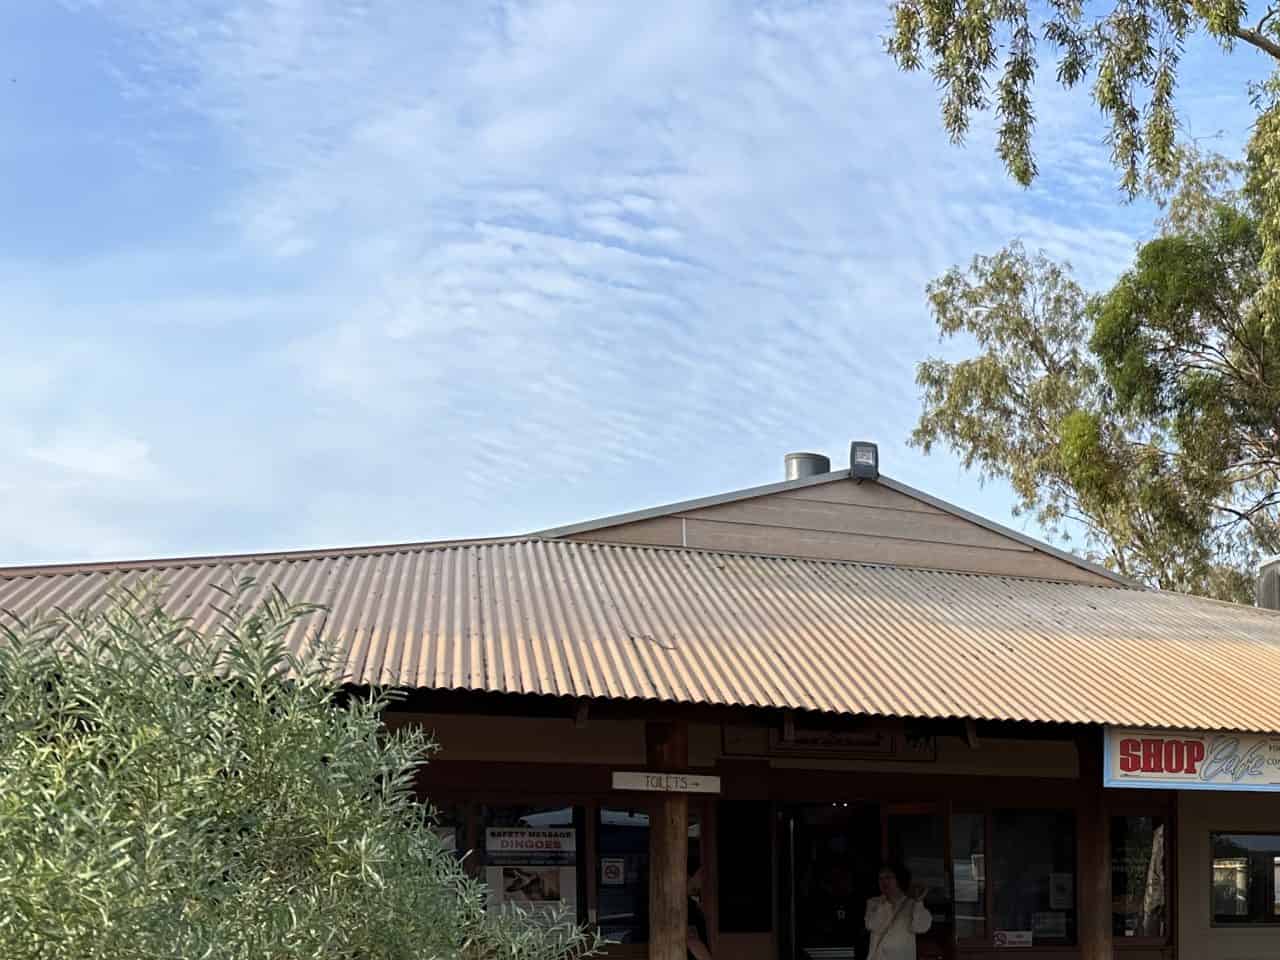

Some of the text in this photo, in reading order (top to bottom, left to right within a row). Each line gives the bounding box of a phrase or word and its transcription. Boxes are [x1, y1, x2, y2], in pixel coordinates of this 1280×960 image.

[1119, 738, 1205, 774] SHOP
[646, 775, 687, 789] TOILETS
[500, 839, 561, 849] DINGOES
